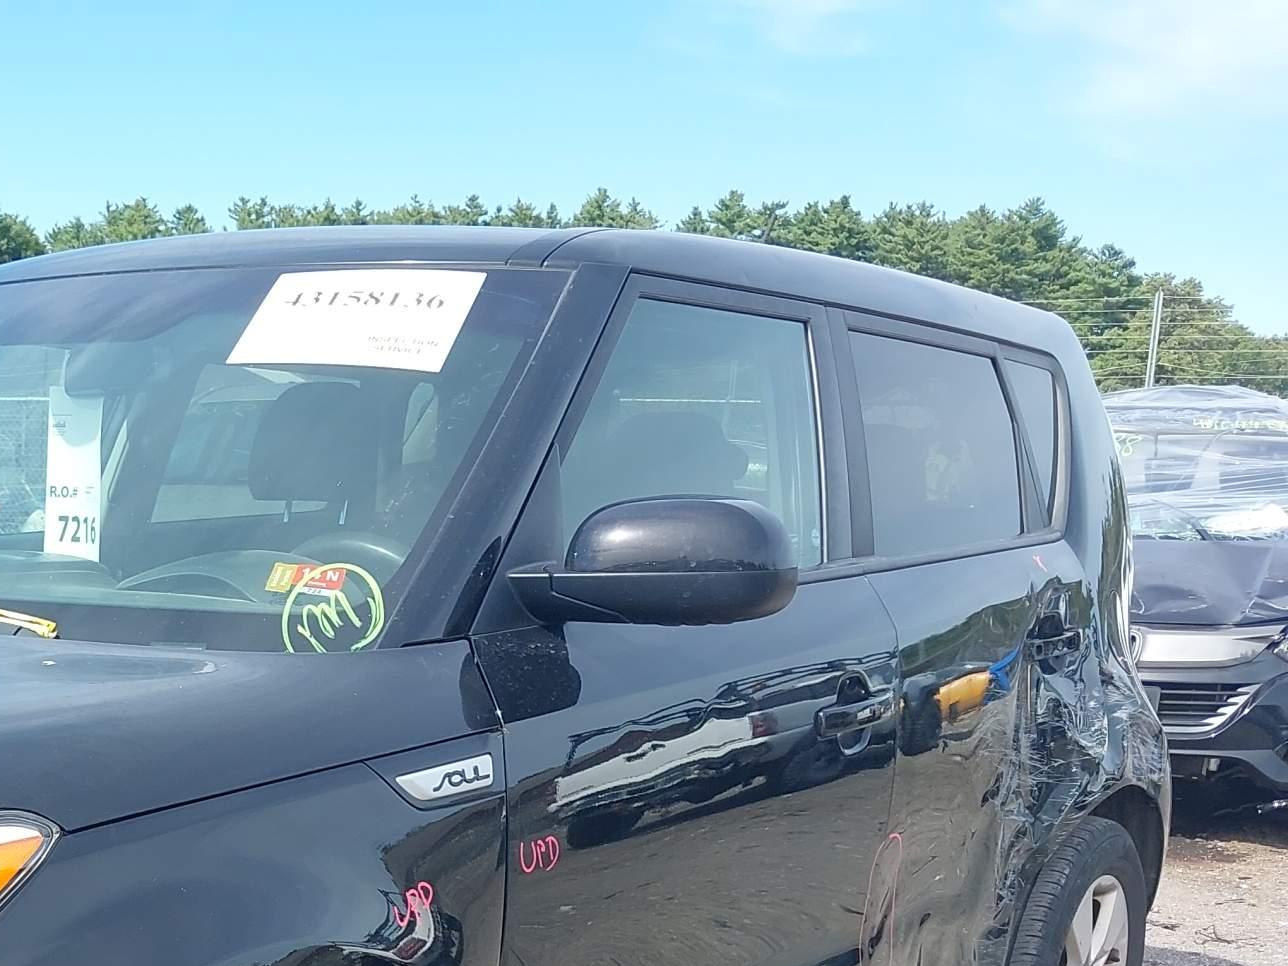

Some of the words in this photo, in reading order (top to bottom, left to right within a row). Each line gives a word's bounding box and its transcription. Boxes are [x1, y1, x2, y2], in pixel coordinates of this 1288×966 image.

[284, 290, 446, 310] 43158136
[57, 514, 97, 545] 7216
[432, 765, 491, 793] SOUL
[519, 835, 560, 873] UPD
